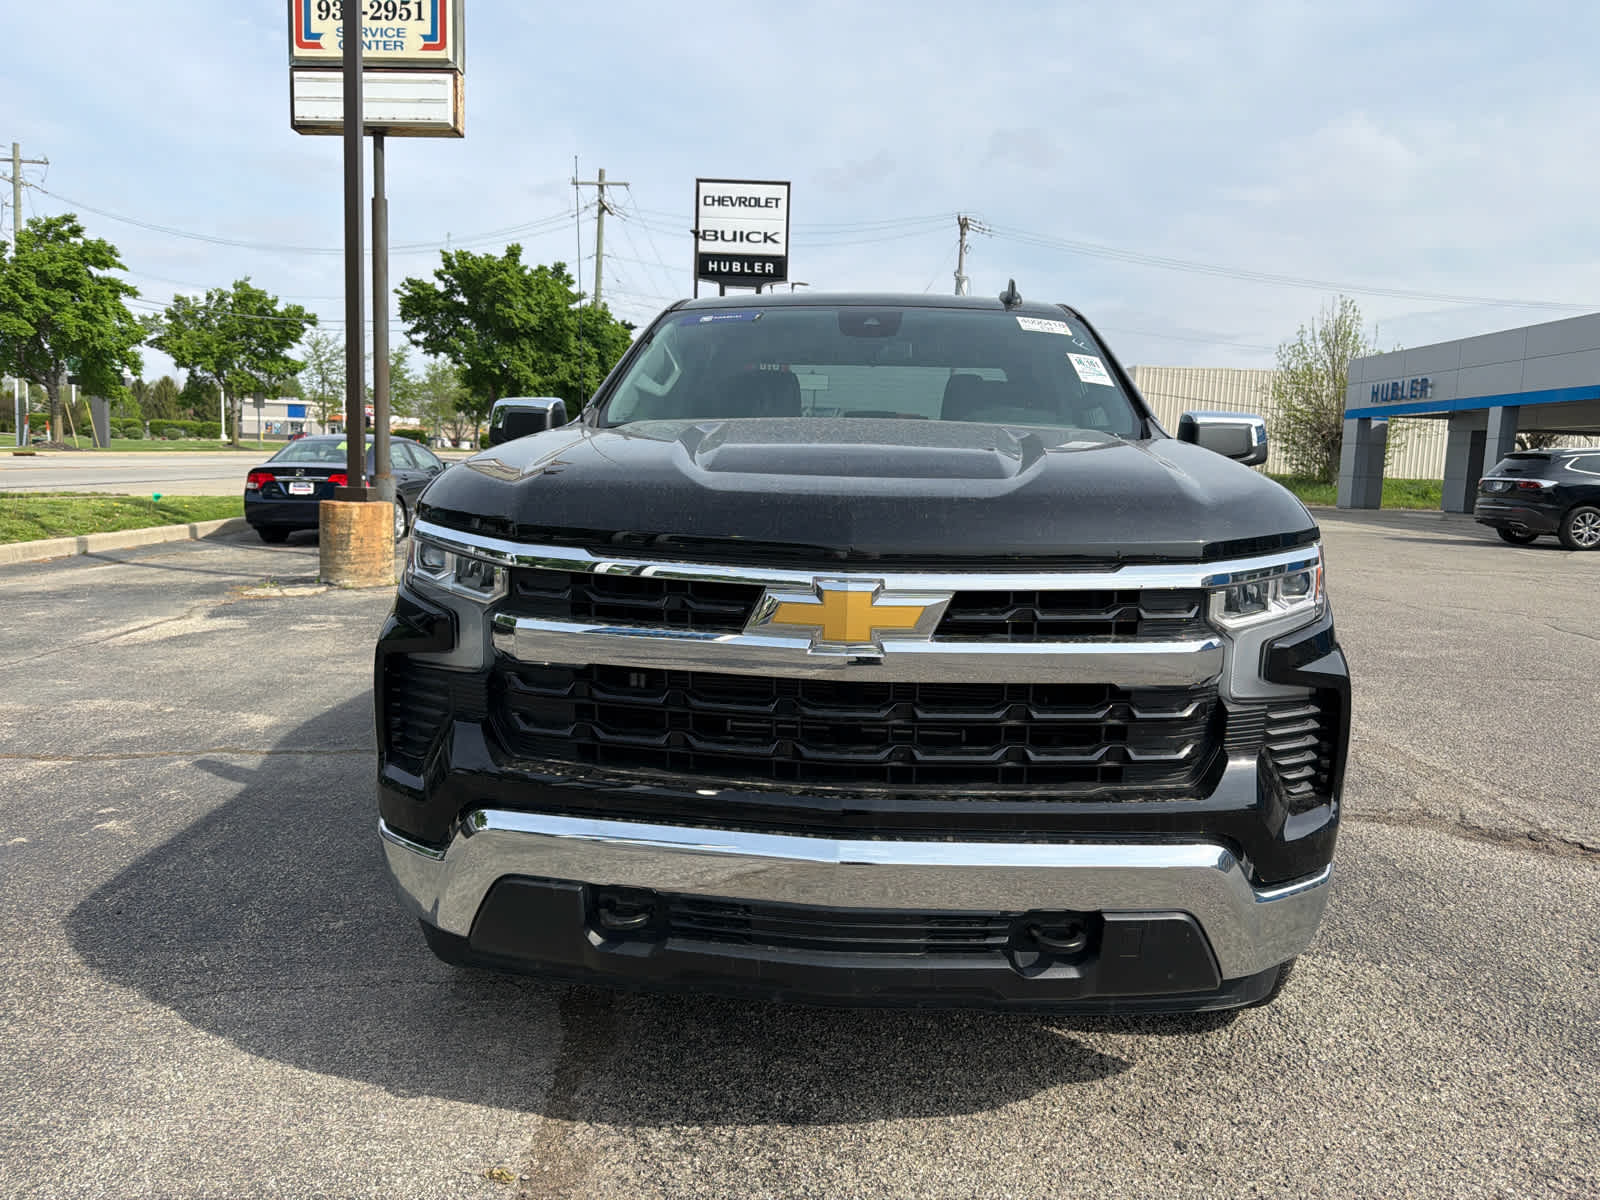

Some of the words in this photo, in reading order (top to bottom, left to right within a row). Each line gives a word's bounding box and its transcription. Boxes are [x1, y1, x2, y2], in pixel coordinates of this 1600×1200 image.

[317, 0, 425, 21] 93-2951
[335, 27, 407, 38] SRVICE
[338, 40, 404, 51] NTER
[703, 195, 782, 208] CHEVROLET
[702, 229, 781, 244] BUICK
[708, 260, 774, 273] HUBLER
[1371, 377, 1431, 403] HUBLER
